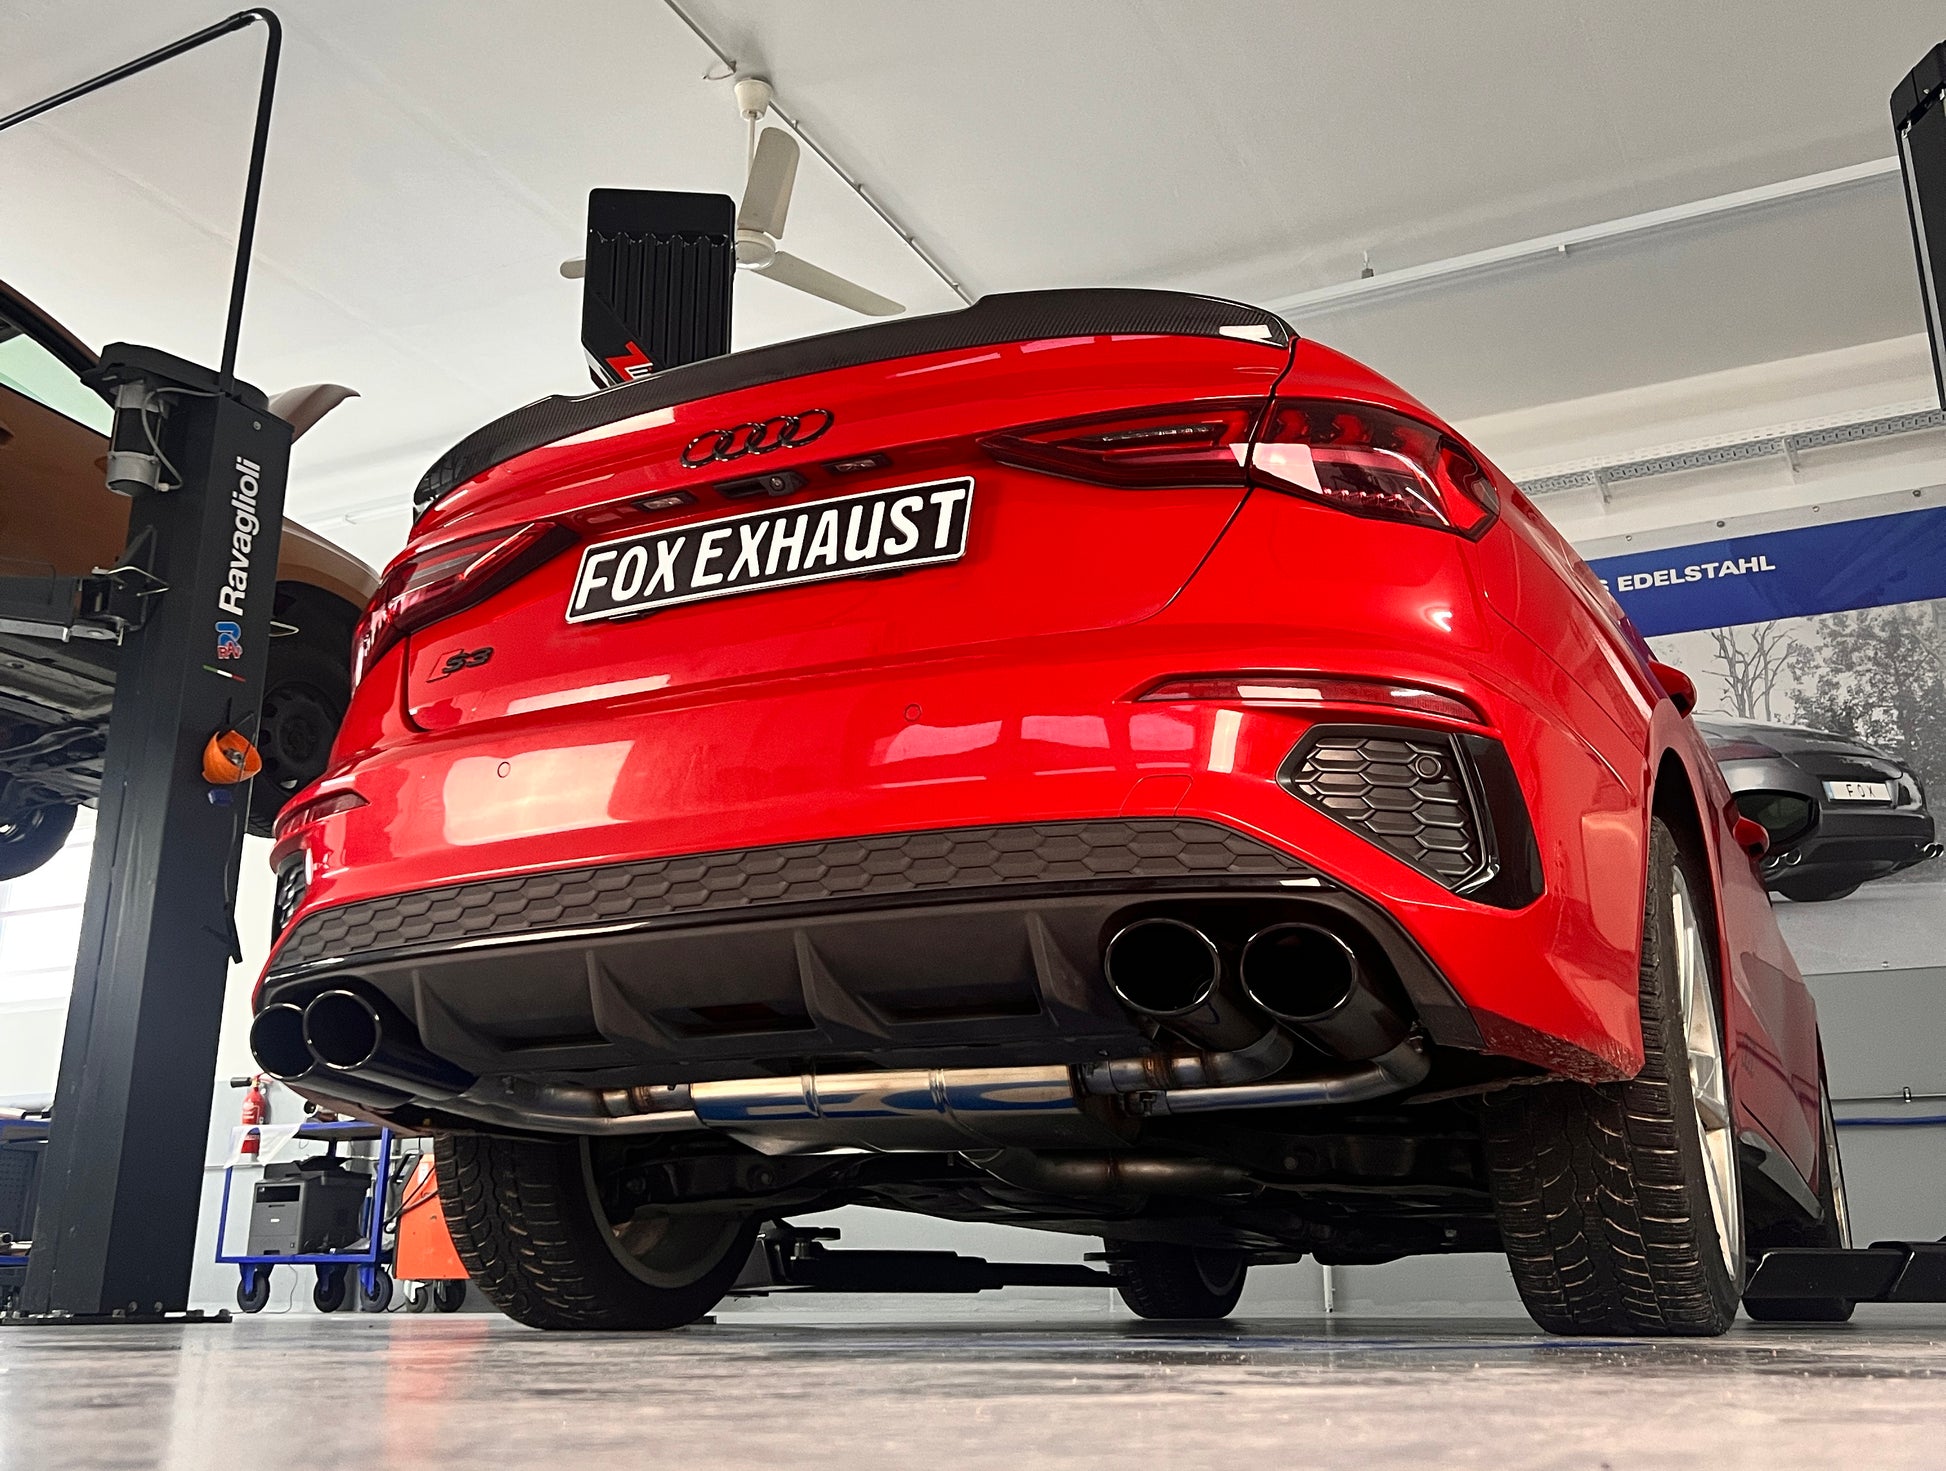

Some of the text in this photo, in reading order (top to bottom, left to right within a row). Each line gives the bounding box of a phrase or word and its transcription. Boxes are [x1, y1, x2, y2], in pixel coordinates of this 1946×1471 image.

[218, 456, 261, 616] Ravaglioli
[575, 488, 966, 610] FOX EXHAUST
[1617, 555, 1776, 592] EDELSTAHL
[1845, 783, 1876, 798] FOX
